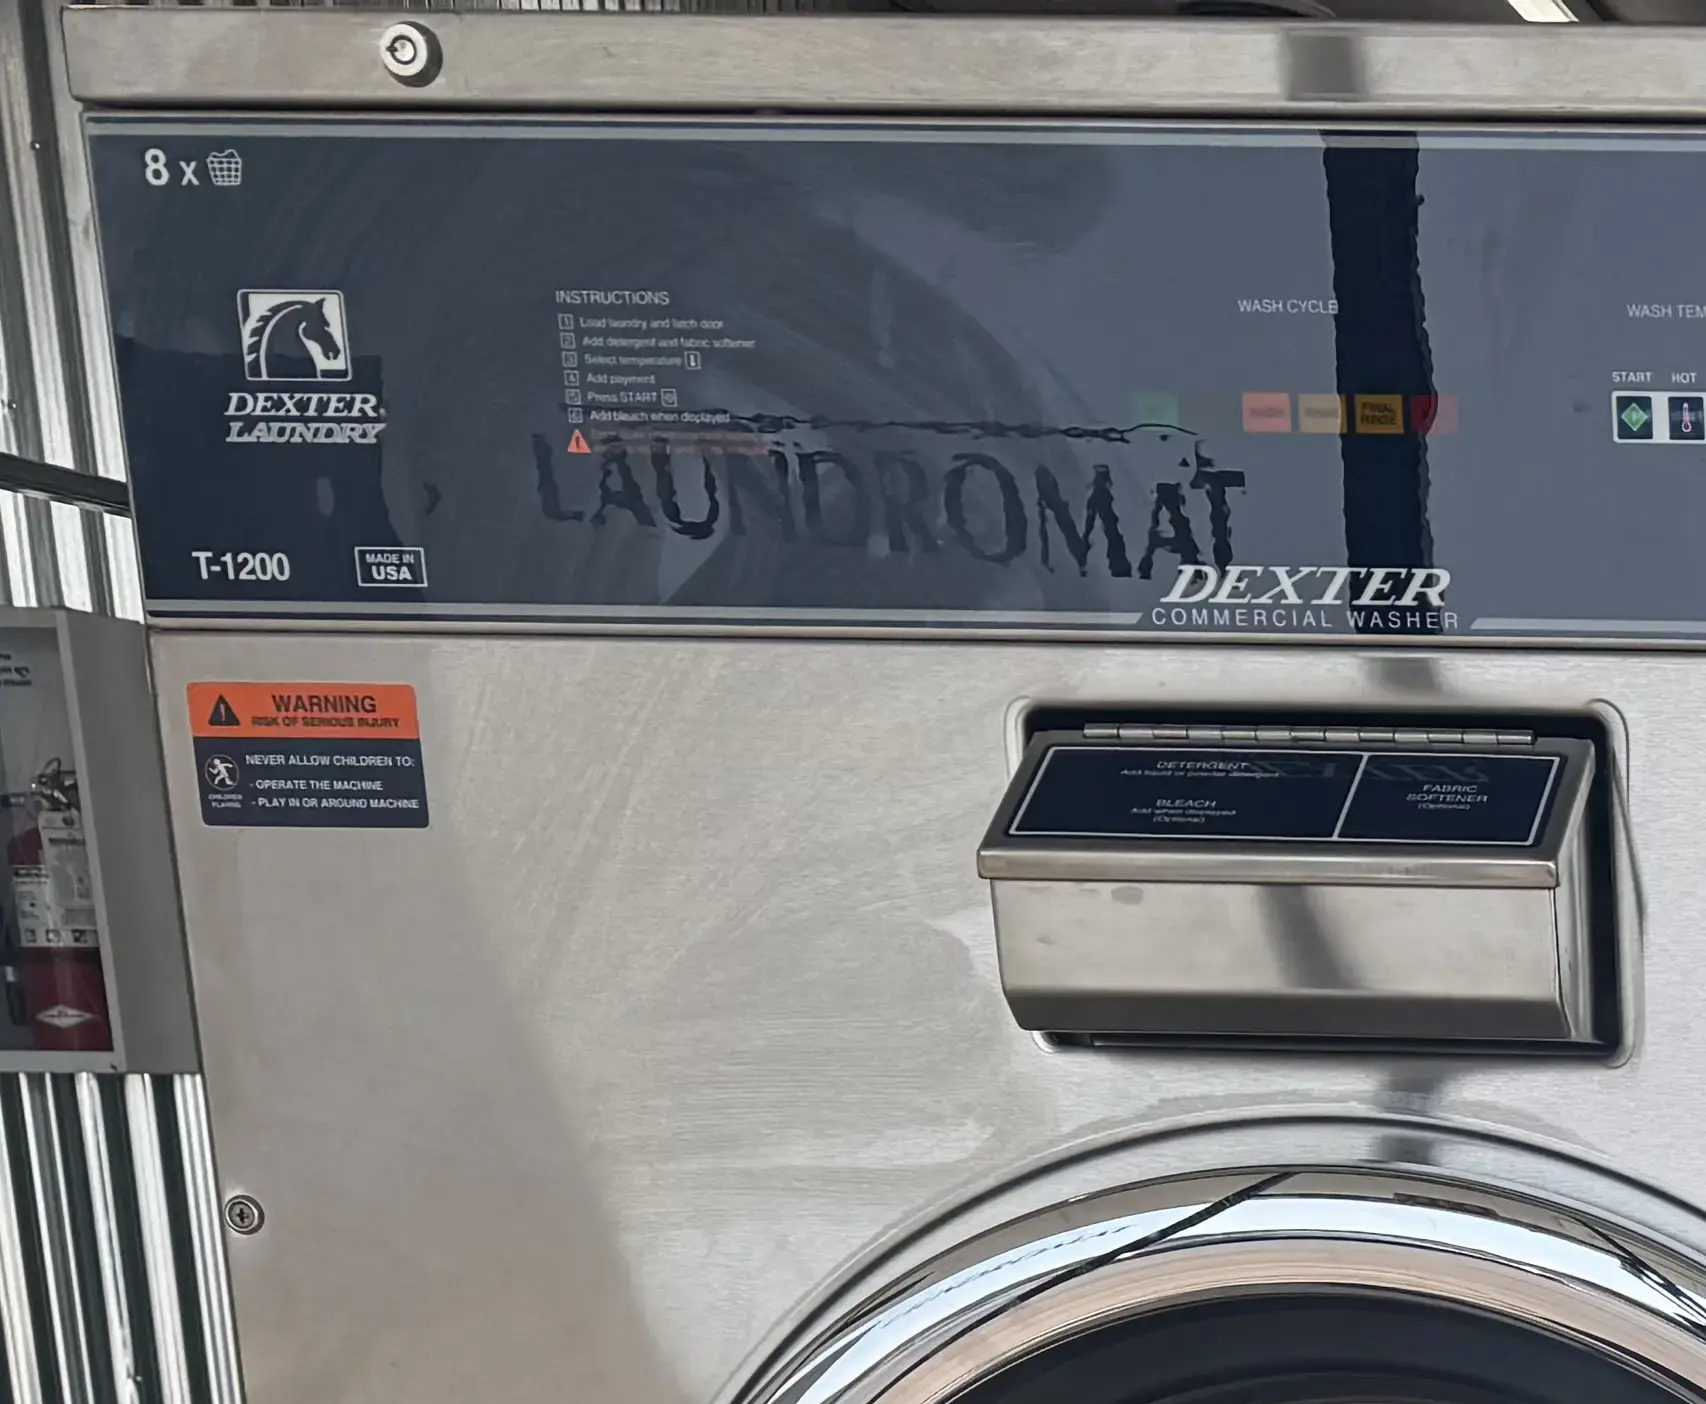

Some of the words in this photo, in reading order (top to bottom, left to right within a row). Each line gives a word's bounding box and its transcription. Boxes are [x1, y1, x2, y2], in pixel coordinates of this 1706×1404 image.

[145, 148, 170, 186] 8
[555, 290, 669, 305] INSTRUCTIONS
[1238, 299, 1283, 313] WASH
[1287, 300, 1339, 314] CYCLE
[1626, 304, 1672, 318] WASH
[1612, 372, 1653, 383] START
[1671, 372, 1697, 384] HOT
[224, 392, 378, 417] DEXTER
[226, 422, 387, 444] LAUNDRY
[530, 431, 1246, 581] LAUNDROMAT
[365, 553, 400, 564] MADE
[402, 553, 414, 564] IN
[192, 552, 290, 581] T-1200
[372, 566, 412, 580] USA
[1159, 564, 1450, 607] DEXTER
[1151, 607, 1332, 627] COMMERCIAL
[1346, 610, 1457, 629] WASHER
[271, 695, 377, 713] WARNING
[252, 716, 278, 727] RISK
[284, 716, 297, 727] OF
[303, 716, 354, 727] SERIOUS
[358, 717, 399, 728] INJURY
[245, 755, 285, 765] NEVER
[288, 755, 330, 765] ALLOW
[333, 756, 392, 766] CHILDREN
[1157, 761, 1248, 770] DETERGENT
[256, 780, 307, 790] OPERATE
[309, 780, 330, 790] THE
[333, 781, 383, 791] MACHINE
[1422, 784, 1478, 793] FABRIC
[258, 798, 285, 808] PLAY
[288, 798, 300, 807] IN
[303, 798, 318, 808] OR
[321, 798, 367, 809] AROUND
[370, 799, 419, 809] MACHINE
[1156, 799, 1216, 807] BLEACH
[1406, 794, 1488, 802] SOFTENER
